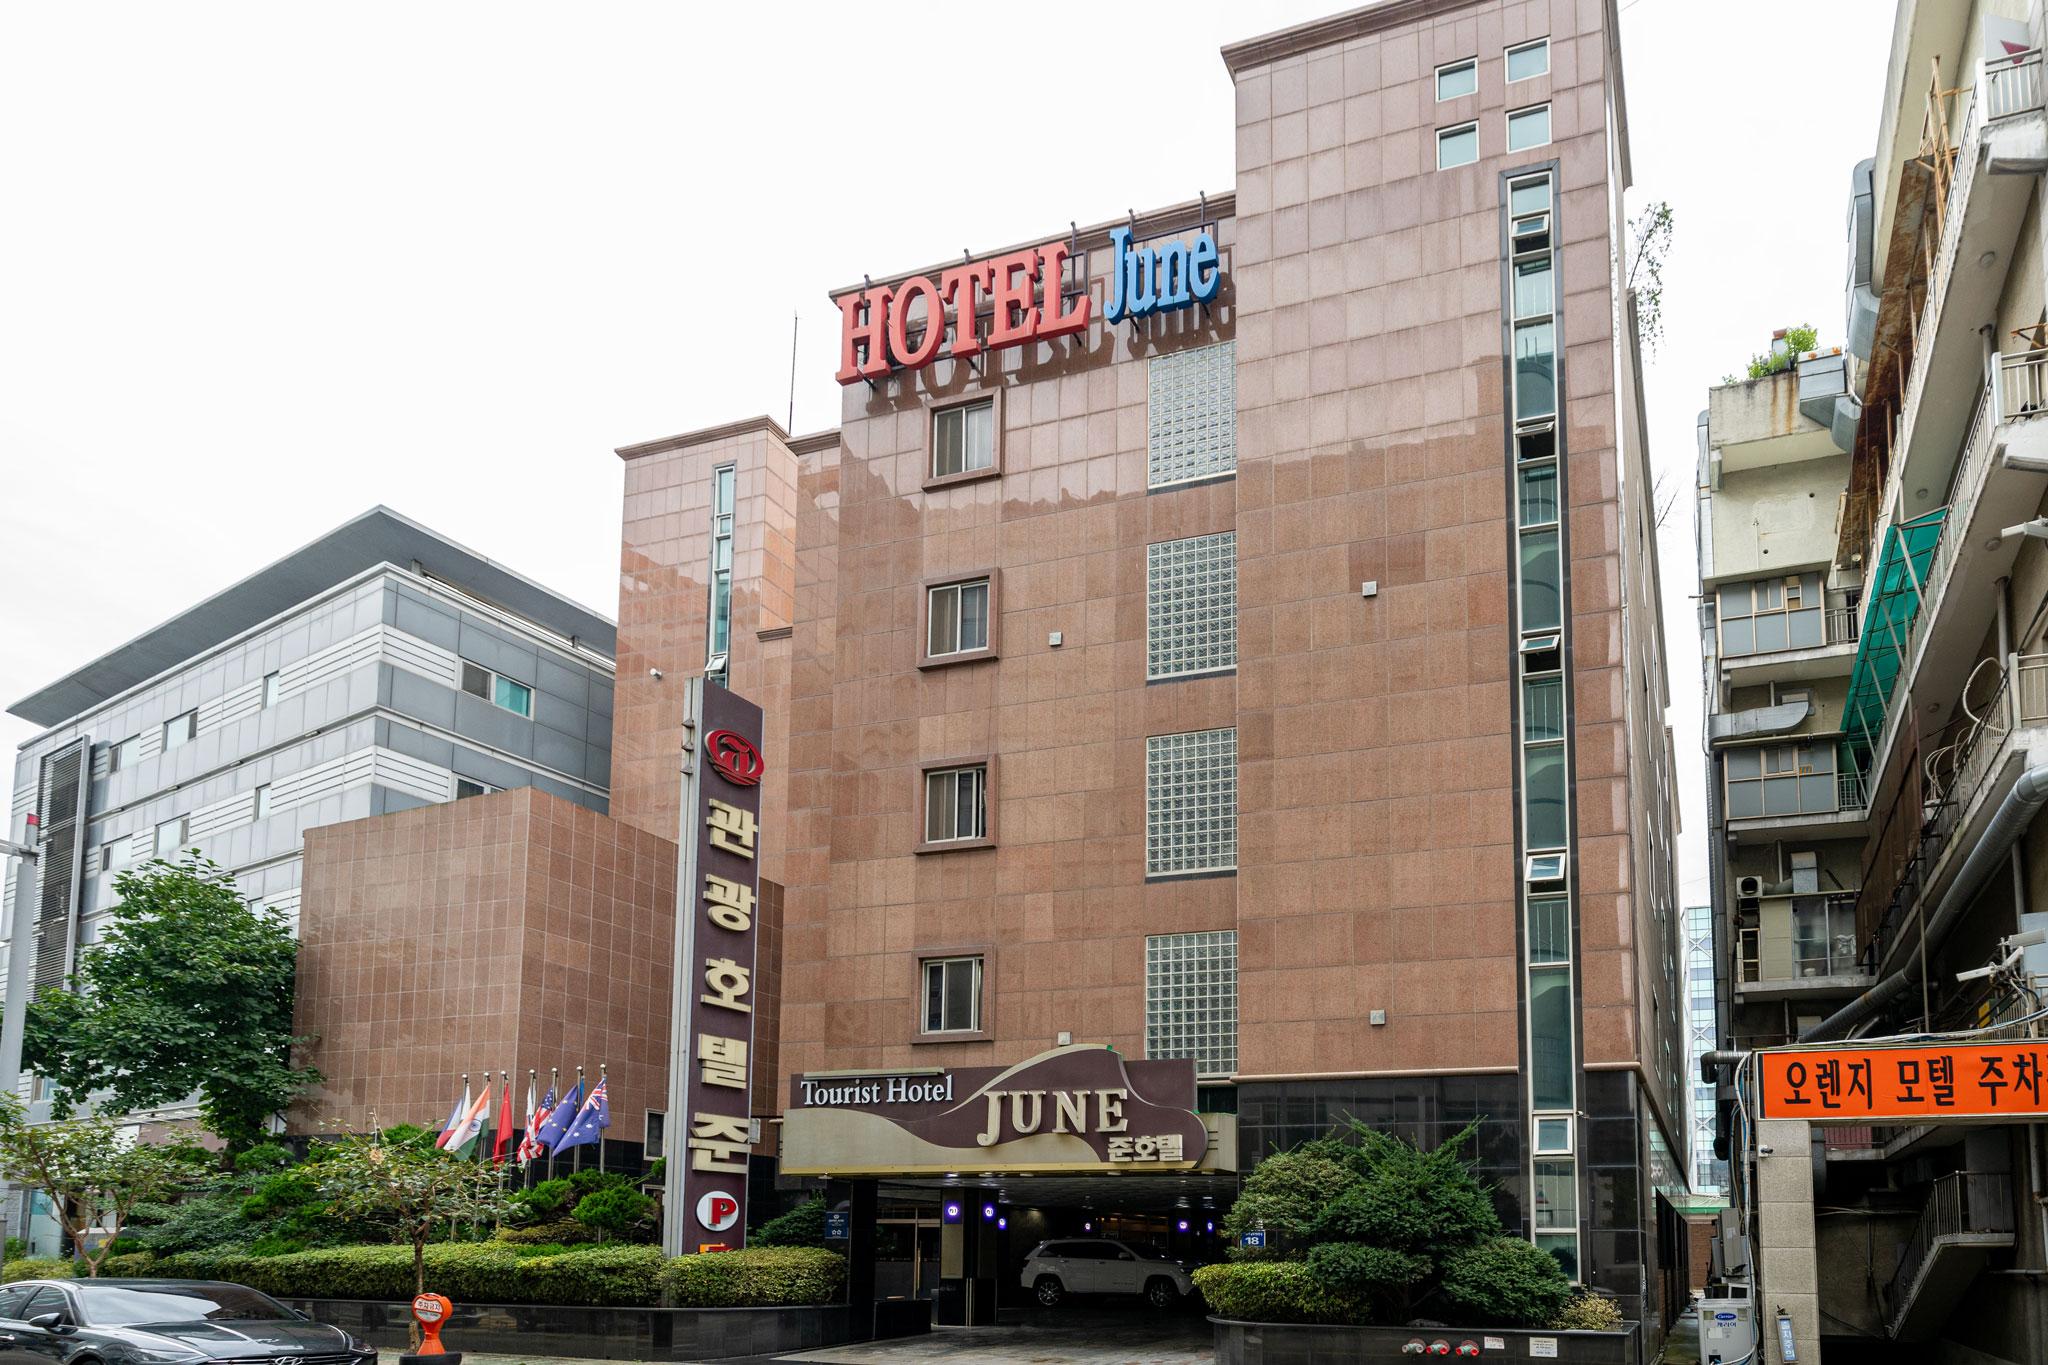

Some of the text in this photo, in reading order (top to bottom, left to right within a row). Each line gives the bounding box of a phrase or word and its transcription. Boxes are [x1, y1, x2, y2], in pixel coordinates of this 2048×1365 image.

[835, 226, 1221, 386] HOTEL June
[800, 1074, 953, 1105] Tourist Hotel
[1784, 1052, 2048, 1110] 오렌지 모텔 주차
[976, 1088, 1128, 1147] JUNE
[1108, 1134, 1184, 1162] 준호텔
[708, 1197, 737, 1225] P
[1245, 1237, 1259, 1245] 18
